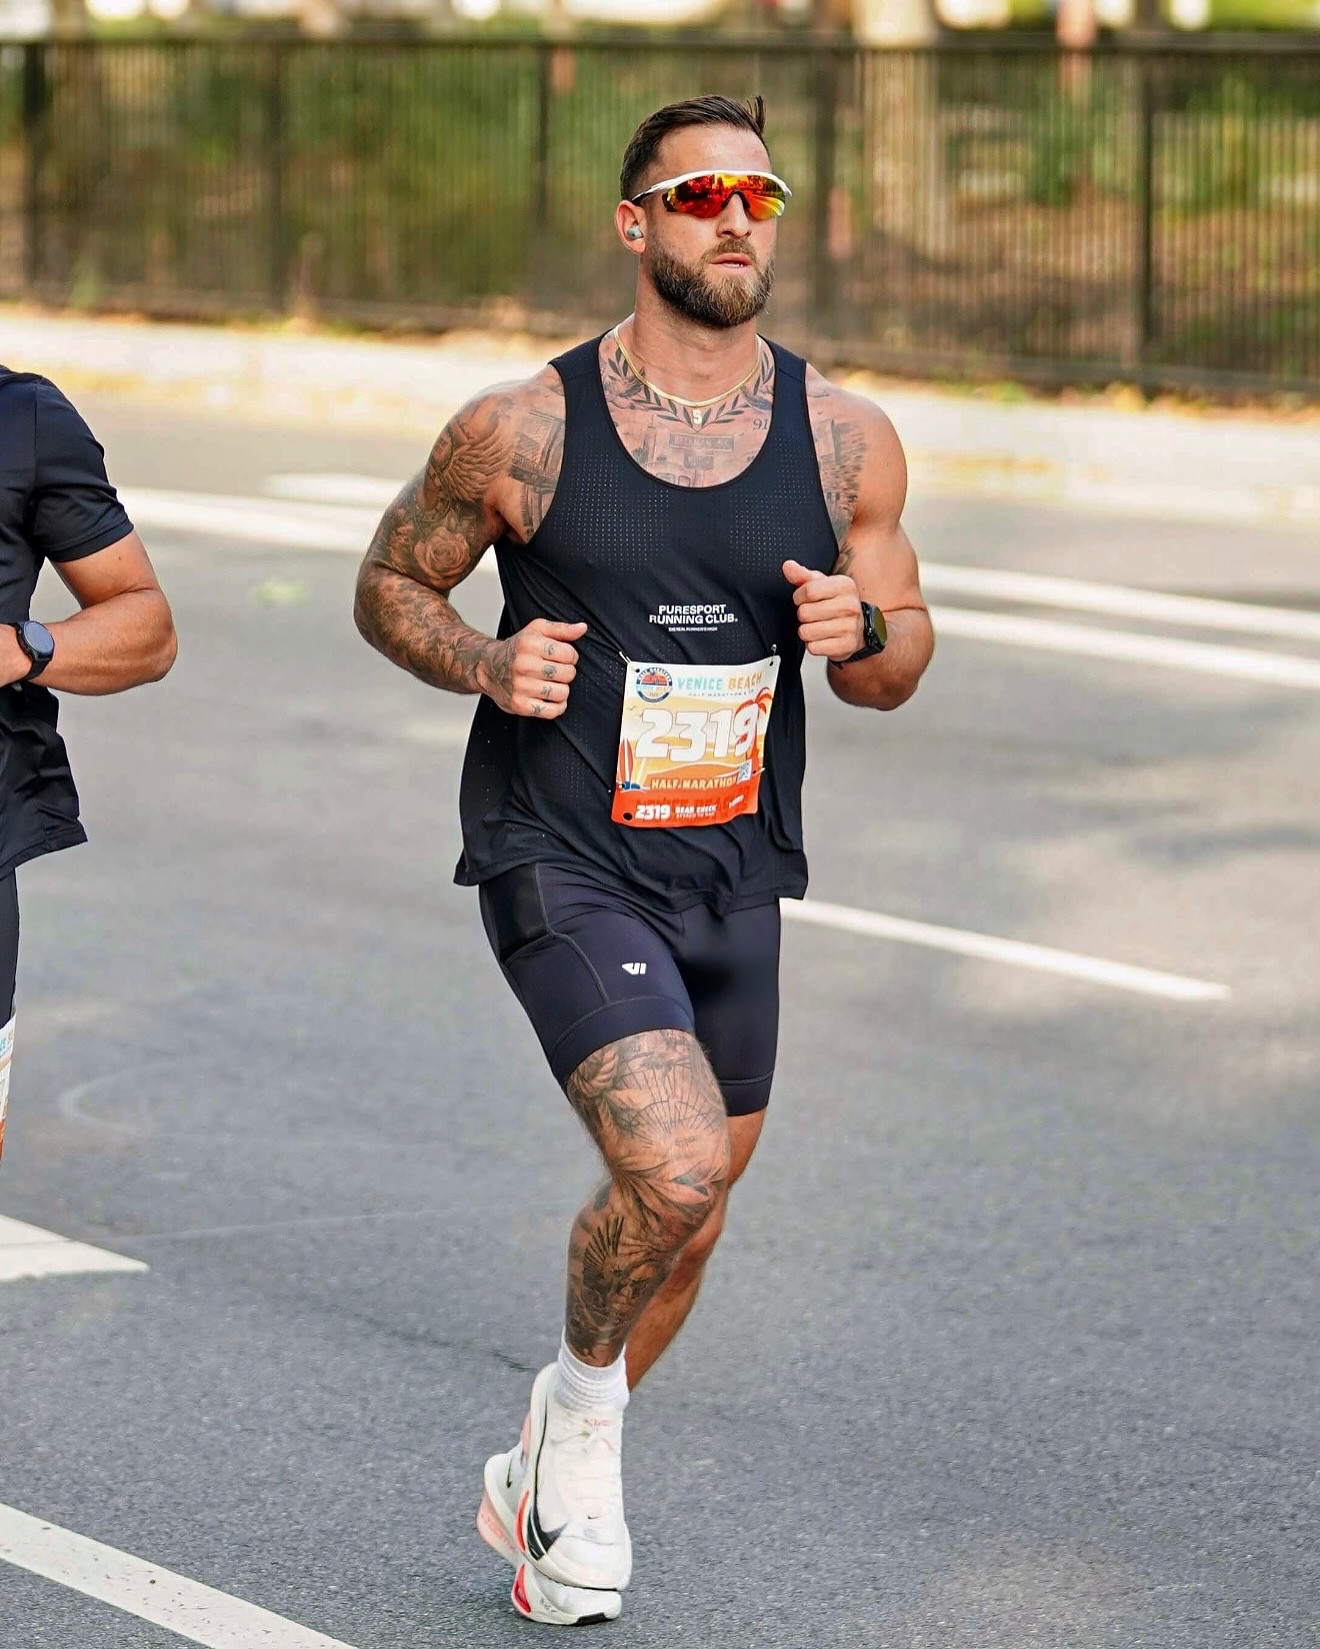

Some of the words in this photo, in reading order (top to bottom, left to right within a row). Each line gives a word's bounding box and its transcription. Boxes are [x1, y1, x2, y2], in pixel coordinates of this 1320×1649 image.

[658, 604, 726, 614] PURESPORT
[649, 614, 703, 625] RUNNING
[705, 613, 738, 624] CLUB.
[677, 676, 722, 690] VENICE
[727, 672, 763, 690] BEACH
[635, 703, 759, 762] 2319
[634, 804, 671, 821] 2319
